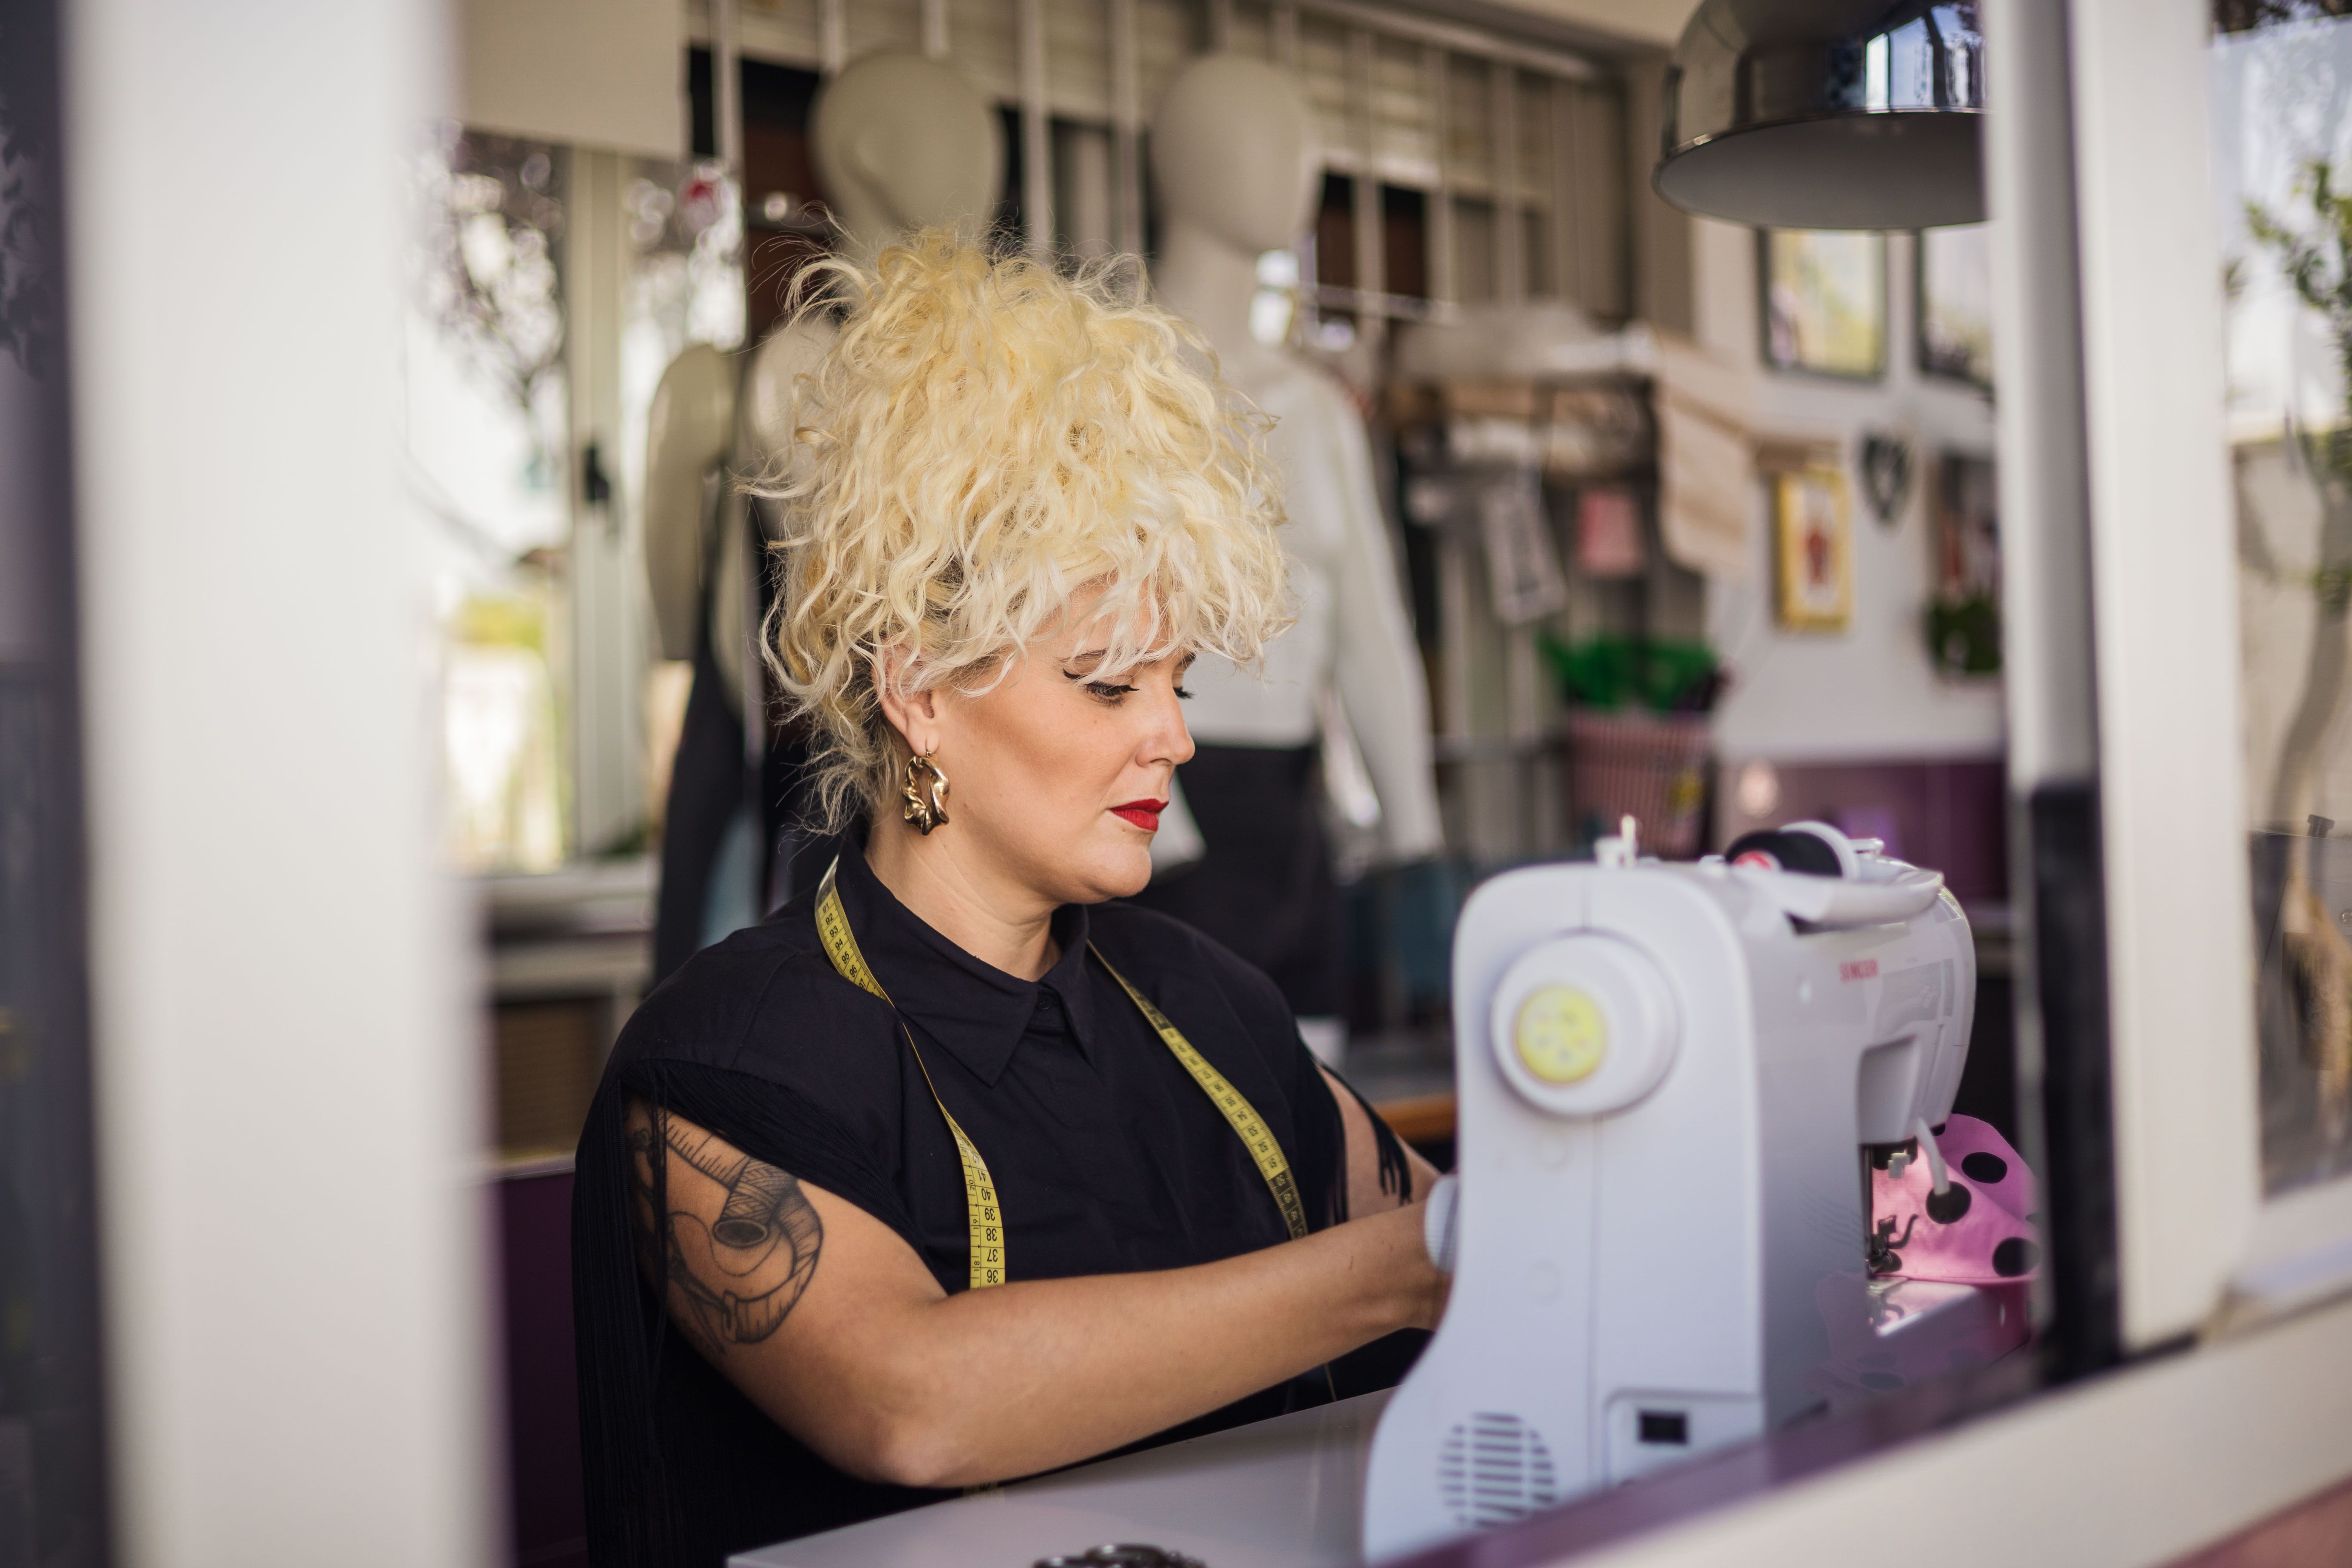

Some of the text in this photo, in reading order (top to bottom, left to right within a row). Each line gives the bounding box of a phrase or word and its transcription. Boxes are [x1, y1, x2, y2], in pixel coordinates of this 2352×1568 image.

[826, 913, 834, 925] 92
[830, 926, 838, 937] 93
[836, 938, 843, 950] 94
[842, 951, 849, 964] 95
[850, 965, 857, 977] 96
[1238, 1111, 1247, 1121] 54
[1248, 1126, 1258, 1136] 53
[1259, 1141, 1268, 1152] 52
[1268, 1158, 1277, 1168] 51
[978, 1170, 986, 1182] 41
[968, 1179, 975, 1191] 20
[981, 1188, 991, 1201] 40
[985, 1208, 995, 1221] 39
[973, 1219, 979, 1229] 19
[986, 1228, 997, 1241] 38
[987, 1249, 998, 1262] 37
[974, 1261, 980, 1271] 18
[987, 1269, 998, 1283] 36
